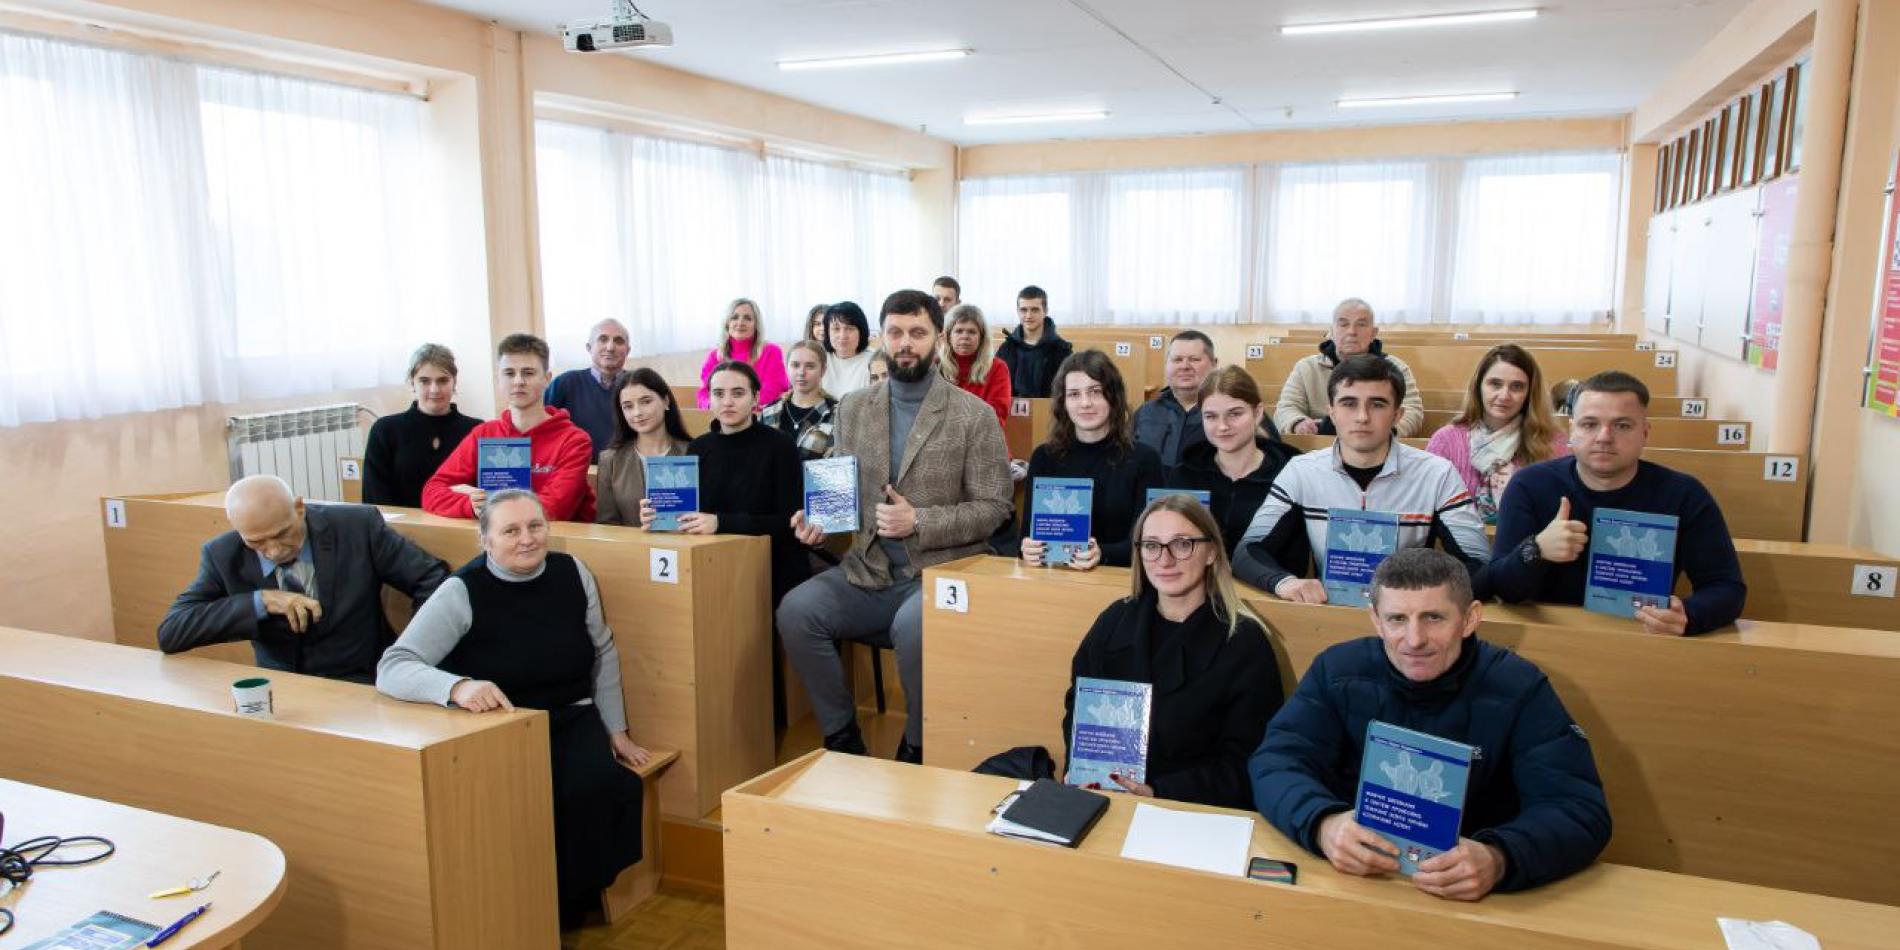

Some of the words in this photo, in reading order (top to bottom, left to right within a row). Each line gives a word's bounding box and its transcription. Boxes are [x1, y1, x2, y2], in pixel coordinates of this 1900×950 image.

[1118, 345, 1128, 354] 22
[1658, 355, 1672, 364] 24
[1015, 403, 1026, 414] 14
[1685, 403, 1702, 414] 20
[1724, 428, 1742, 440] 16
[346, 464, 354, 476] 5
[1771, 461, 1792, 477] 12
[112, 507, 119, 523] 1
[658, 556, 669, 577] 2
[1867, 572, 1882, 591] 8
[946, 586, 957, 605] 3
